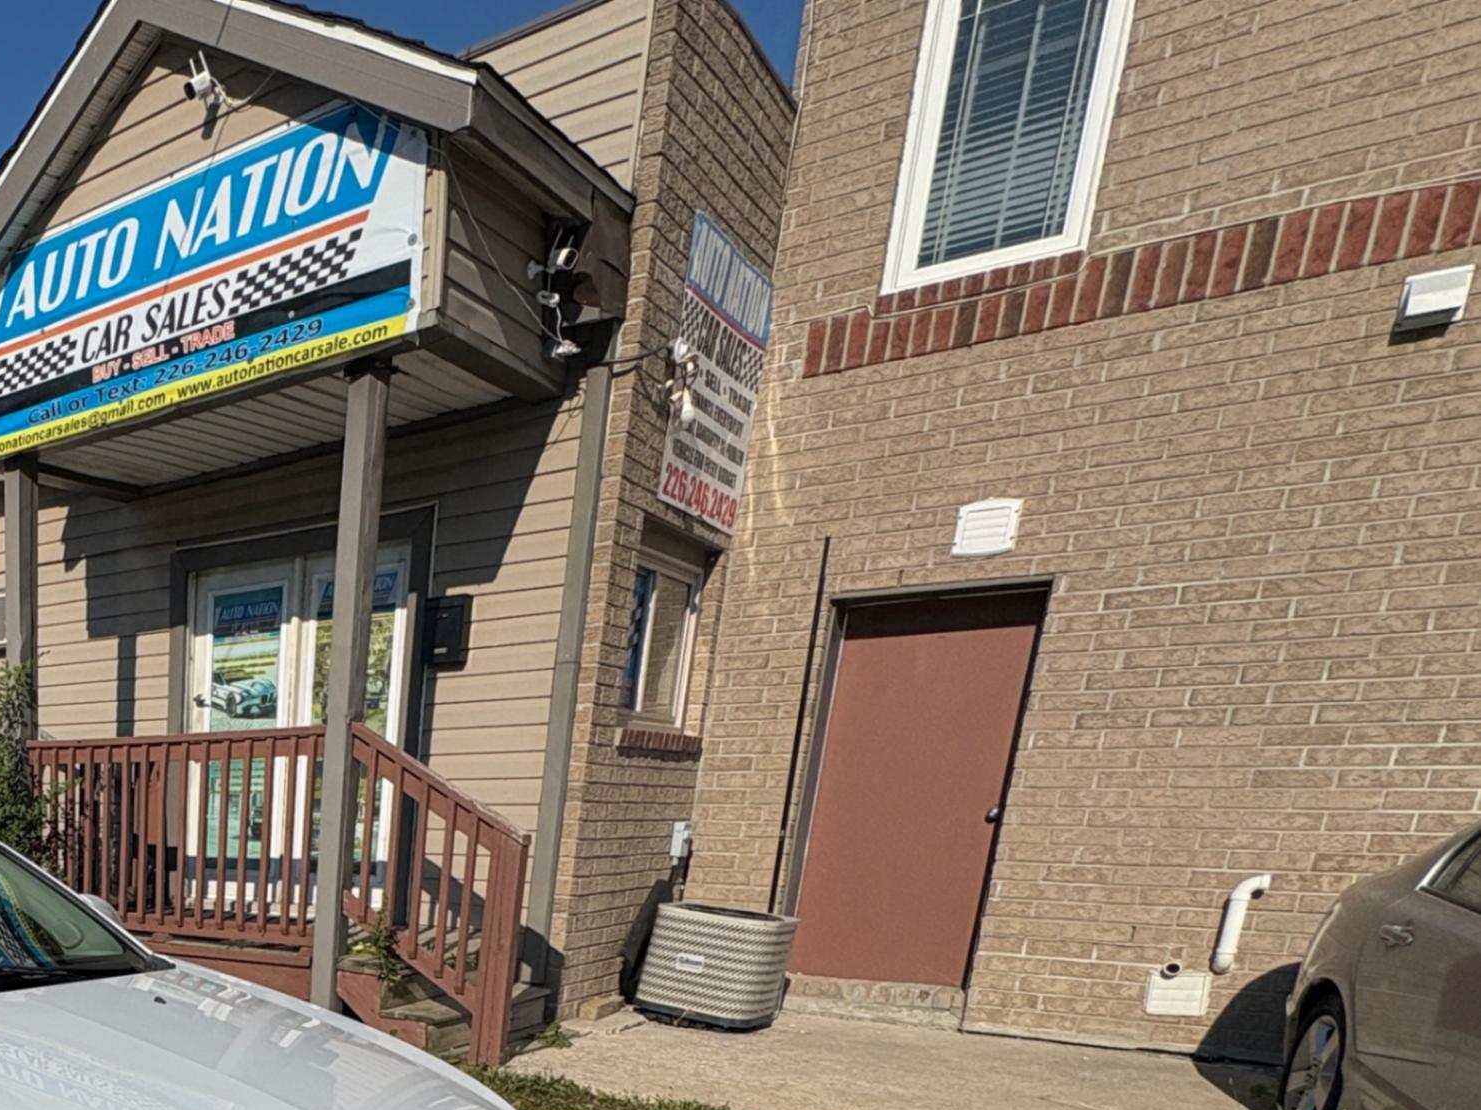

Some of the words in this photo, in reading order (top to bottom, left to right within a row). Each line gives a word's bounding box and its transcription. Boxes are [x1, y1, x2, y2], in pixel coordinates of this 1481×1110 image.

[5, 215, 140, 328] AUTO
[154, 112, 389, 270] NATION
[81, 312, 133, 364] CAR
[141, 278, 230, 343] SALES
[690, 221, 731, 304] AUTO
[721, 253, 770, 340] NATION
[28, 404, 62, 425] Call
[69, 396, 88, 412] or
[154, 318, 323, 385] 226-246-2429
[92, 356, 121, 384] BUY
[131, 344, 170, 371] SELL
[180, 320, 235, 353] TRADE
[697, 308, 720, 363] CAR
[714, 325, 748, 382] SALES
